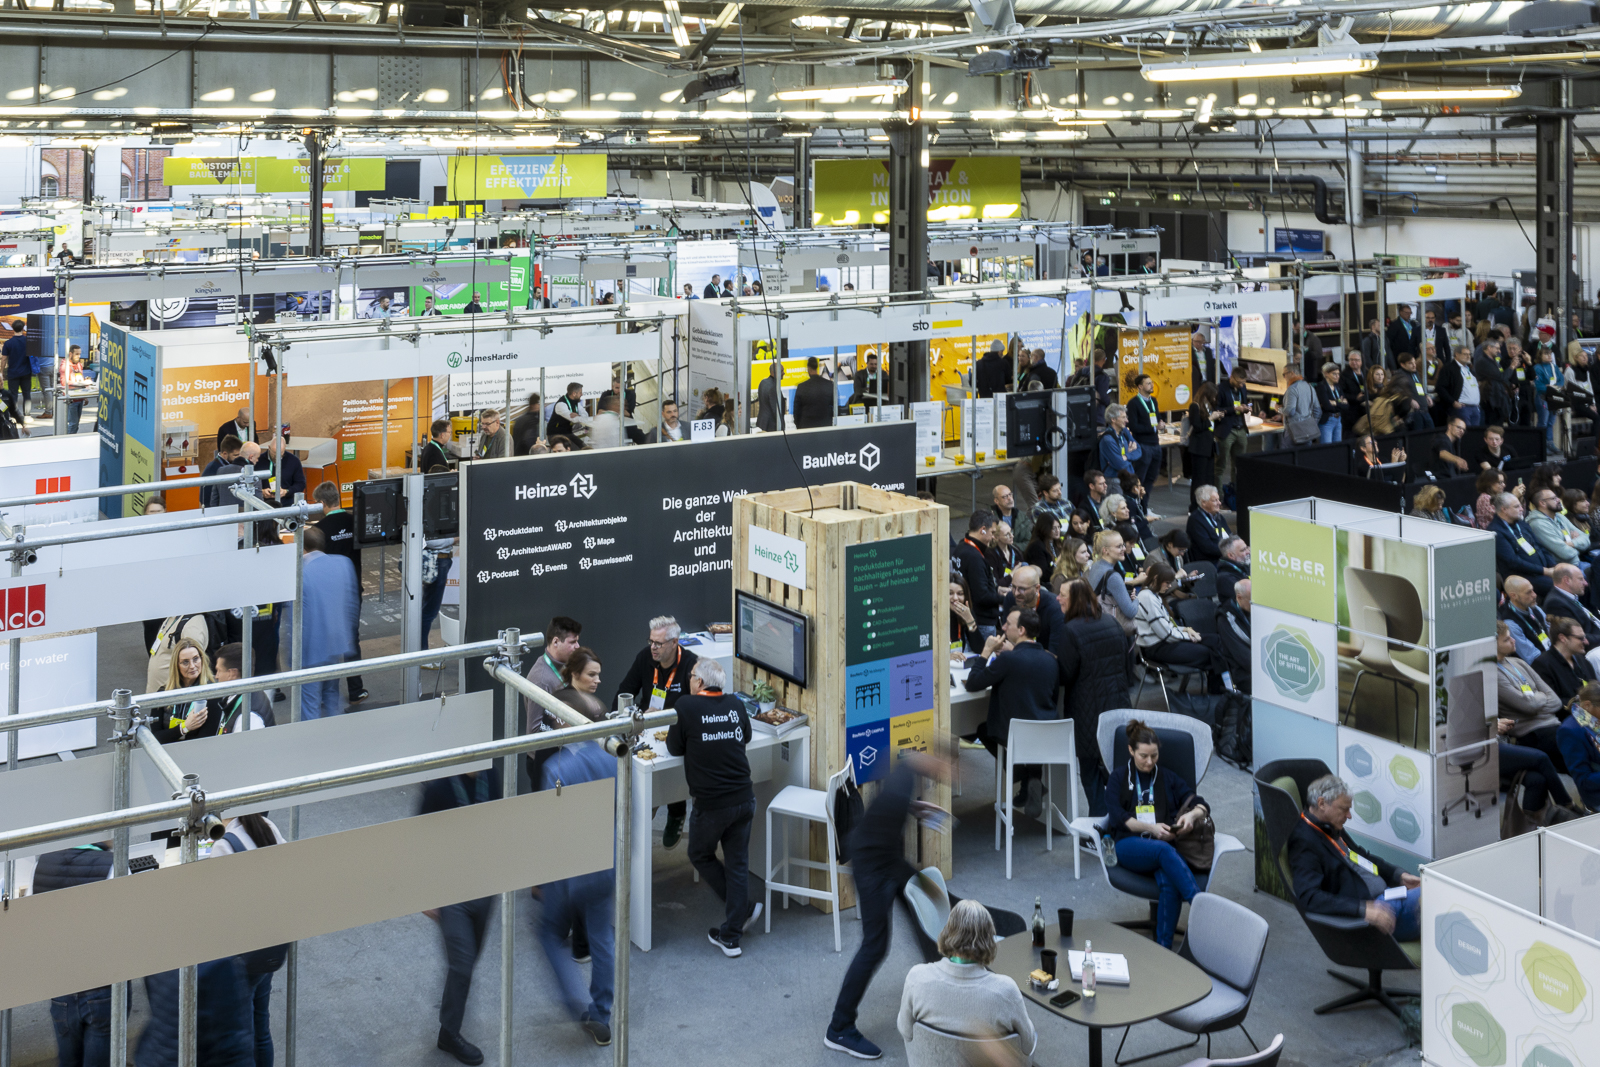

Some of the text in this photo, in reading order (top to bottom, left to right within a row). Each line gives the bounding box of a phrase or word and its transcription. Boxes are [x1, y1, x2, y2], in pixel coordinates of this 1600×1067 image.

[189, 170, 253, 179] BAUELEMENTE
[293, 165, 350, 174] PROUKT &
[490, 164, 568, 176] EFFIZIENZ &
[301, 175, 343, 184] UELT
[485, 174, 572, 188] EFFEKTIVITÄT
[872, 171, 968, 188] MIAL &
[870, 189, 971, 206] INTION
[1212, 301, 1237, 310] Tarkett
[912, 320, 929, 331] sto
[692, 327, 723, 341] Gebäudeklassen
[692, 335, 719, 347] Holzbauweise
[1123, 338, 1147, 348] Beauy
[108, 340, 123, 370] PRO
[465, 353, 518, 362] JamesHardie
[1123, 353, 1159, 365] Circarity
[99, 367, 123, 400] JECTS
[162, 379, 238, 394] ep by Step zu
[162, 391, 250, 406] mabeständigem
[456, 389, 499, 397] Oberflchenvielfalt
[369, 396, 413, 404] emisonsarme
[98, 396, 109, 421] 26
[342, 404, 397, 413] Fassadenlösugen
[162, 411, 183, 420] uen
[694, 421, 713, 432] F.83
[802, 452, 857, 469] BauNetz
[515, 483, 567, 500] Heinze
[880, 483, 905, 491] CAMPUS
[663, 497, 682, 510] Die
[685, 494, 720, 510] ganze
[569, 516, 627, 529] Architekturobjekte
[695, 510, 716, 523] der
[498, 525, 543, 537] Produktdaten
[673, 525, 732, 543] Architektu
[597, 537, 615, 546] Maps
[511, 542, 572, 556] ArchitekturAWARD
[694, 542, 716, 557] und
[754, 544, 782, 564] Heinze
[593, 554, 633, 567] BauwissenKI
[854, 559, 894, 573] Produktdaten
[1258, 549, 1325, 578] KLÖBER
[492, 569, 519, 580] Podcast
[545, 563, 568, 573] Events
[854, 564, 926, 582] nachhaltiges Planen und
[1259, 564, 1270, 573] the
[1274, 568, 1285, 576] art
[1299, 575, 1326, 586] sitting
[854, 583, 873, 593] Bauen
[879, 579, 889, 588] auf
[890, 575, 918, 588] heinze.de
[1440, 578, 1490, 601] KLÖBER
[35, 652, 69, 666] water
[1278, 652, 1300, 664] THE ART
[1286, 662, 1307, 673] SITTING
[702, 714, 728, 724] Heinze
[702, 731, 734, 741] BauNetz
[1458, 939, 1482, 956] DESIGN
[1538, 971, 1569, 992] ENVIRON
[1543, 983, 1563, 998] MENT
[1457, 1020, 1484, 1040] QUALITY
